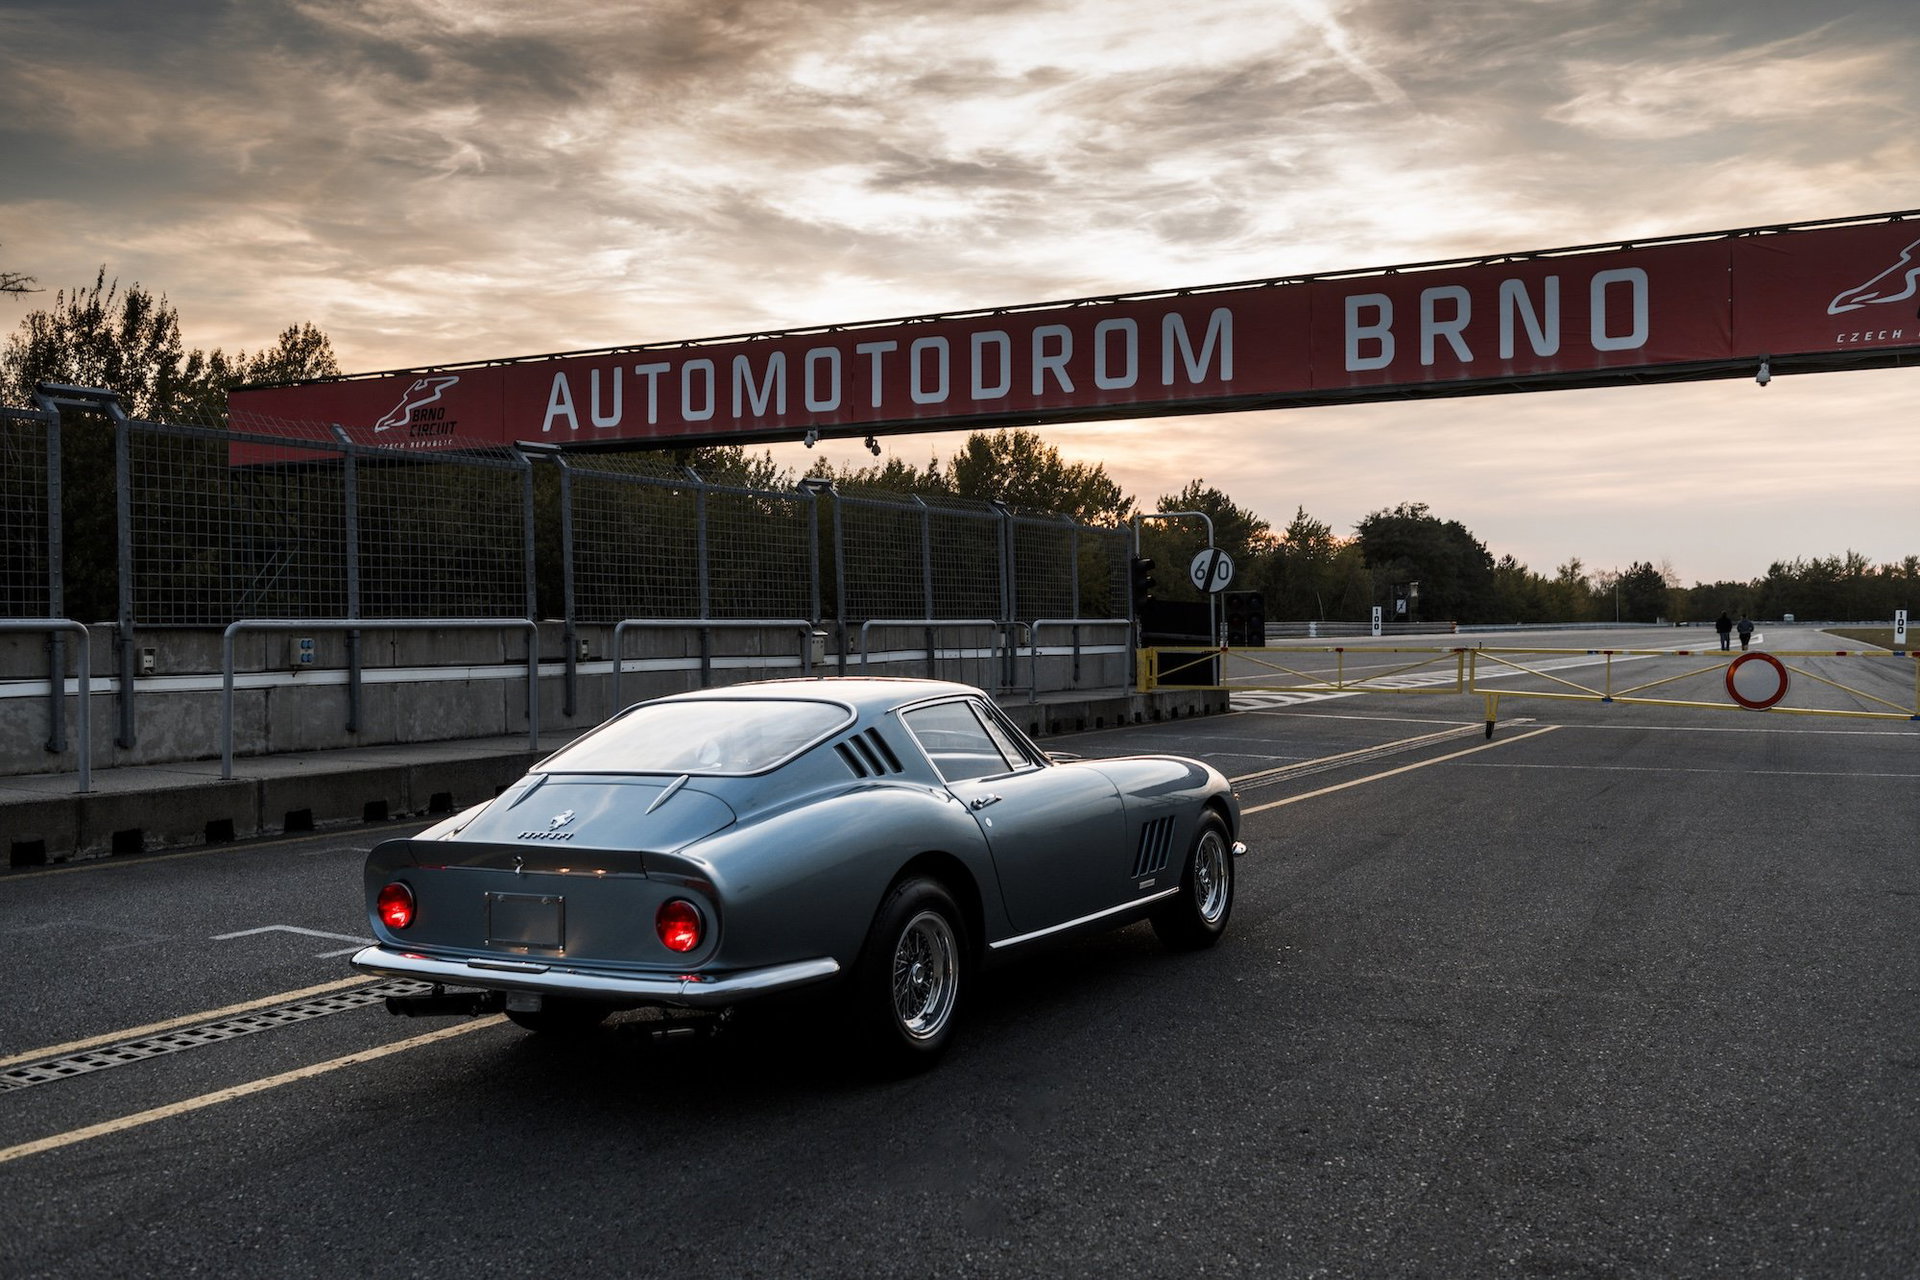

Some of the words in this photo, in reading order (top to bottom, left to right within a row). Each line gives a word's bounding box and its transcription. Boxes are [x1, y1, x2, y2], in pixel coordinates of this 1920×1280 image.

[1836, 329, 1902, 343] CZECH
[542, 307, 1233, 432] AUTOMOTODROM
[1344, 267, 1649, 372] BRNO
[412, 407, 445, 422] BRNO
[409, 421, 457, 437] CIRCUIT
[1194, 560, 1230, 581] 60
[1897, 610, 1905, 634] 100
